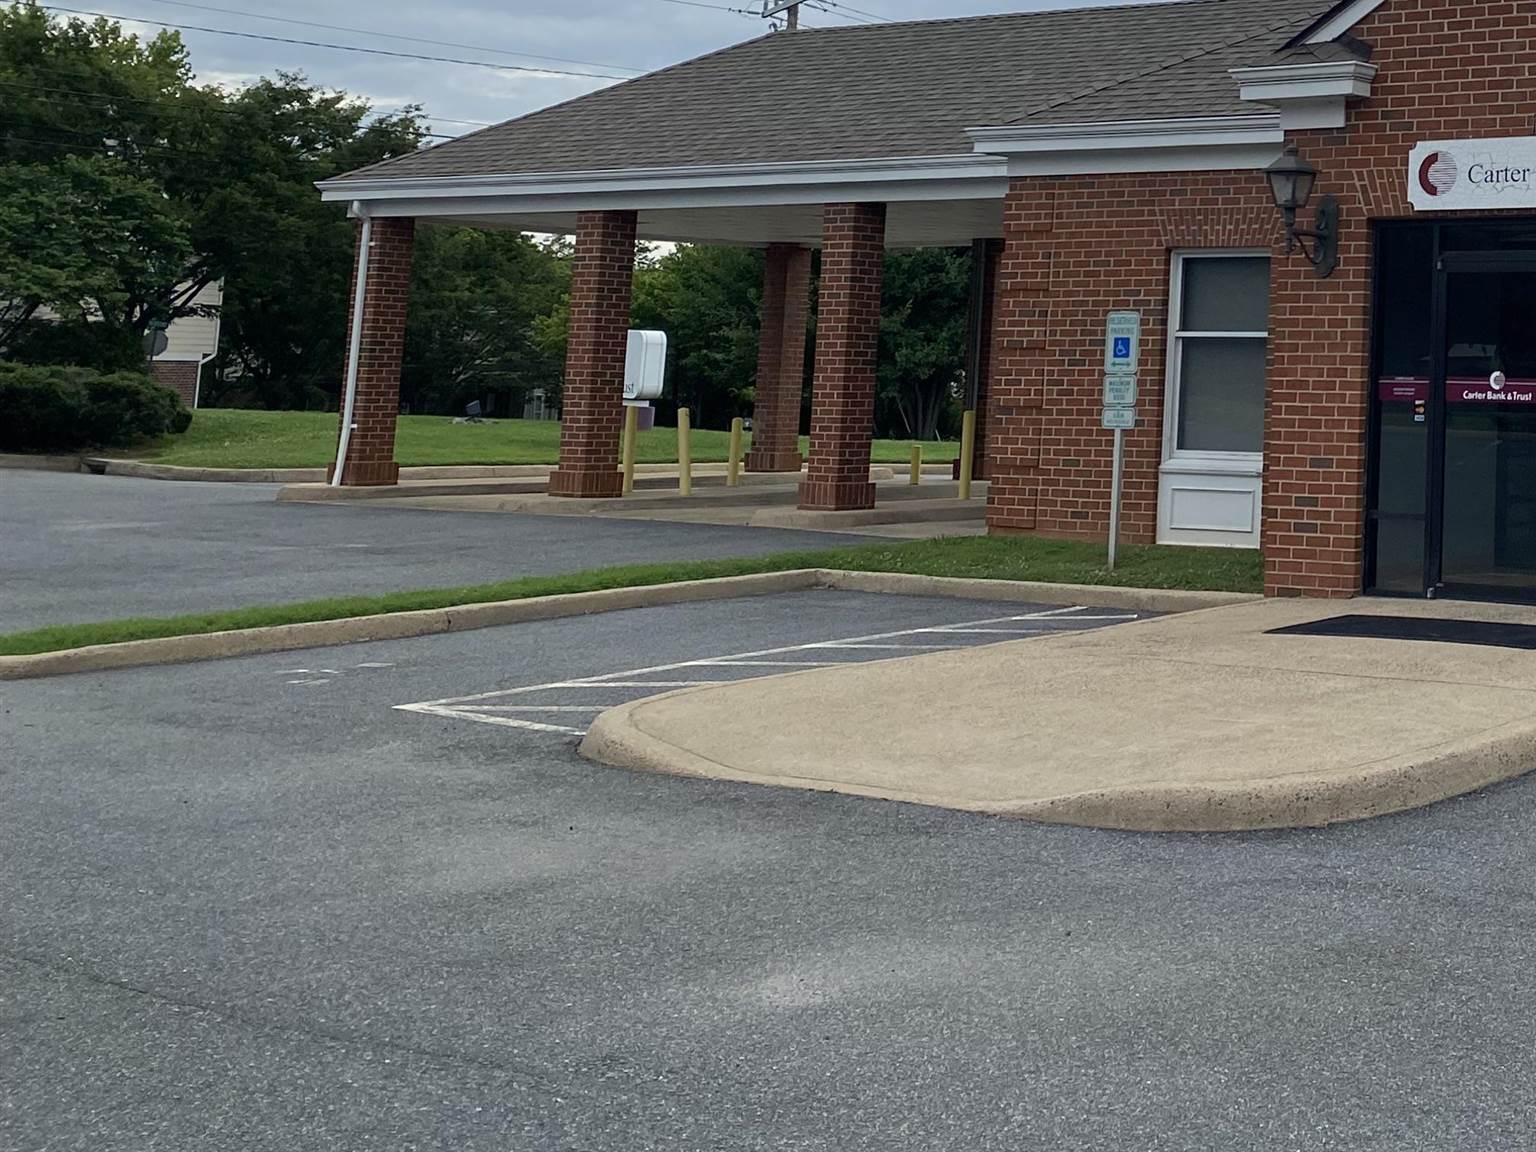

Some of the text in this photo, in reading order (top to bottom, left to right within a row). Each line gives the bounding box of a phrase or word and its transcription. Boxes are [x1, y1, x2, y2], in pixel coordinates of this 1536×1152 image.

[1467, 163, 1530, 184] Carter
[1462, 390, 1532, 401] Carter Bank & Trust
